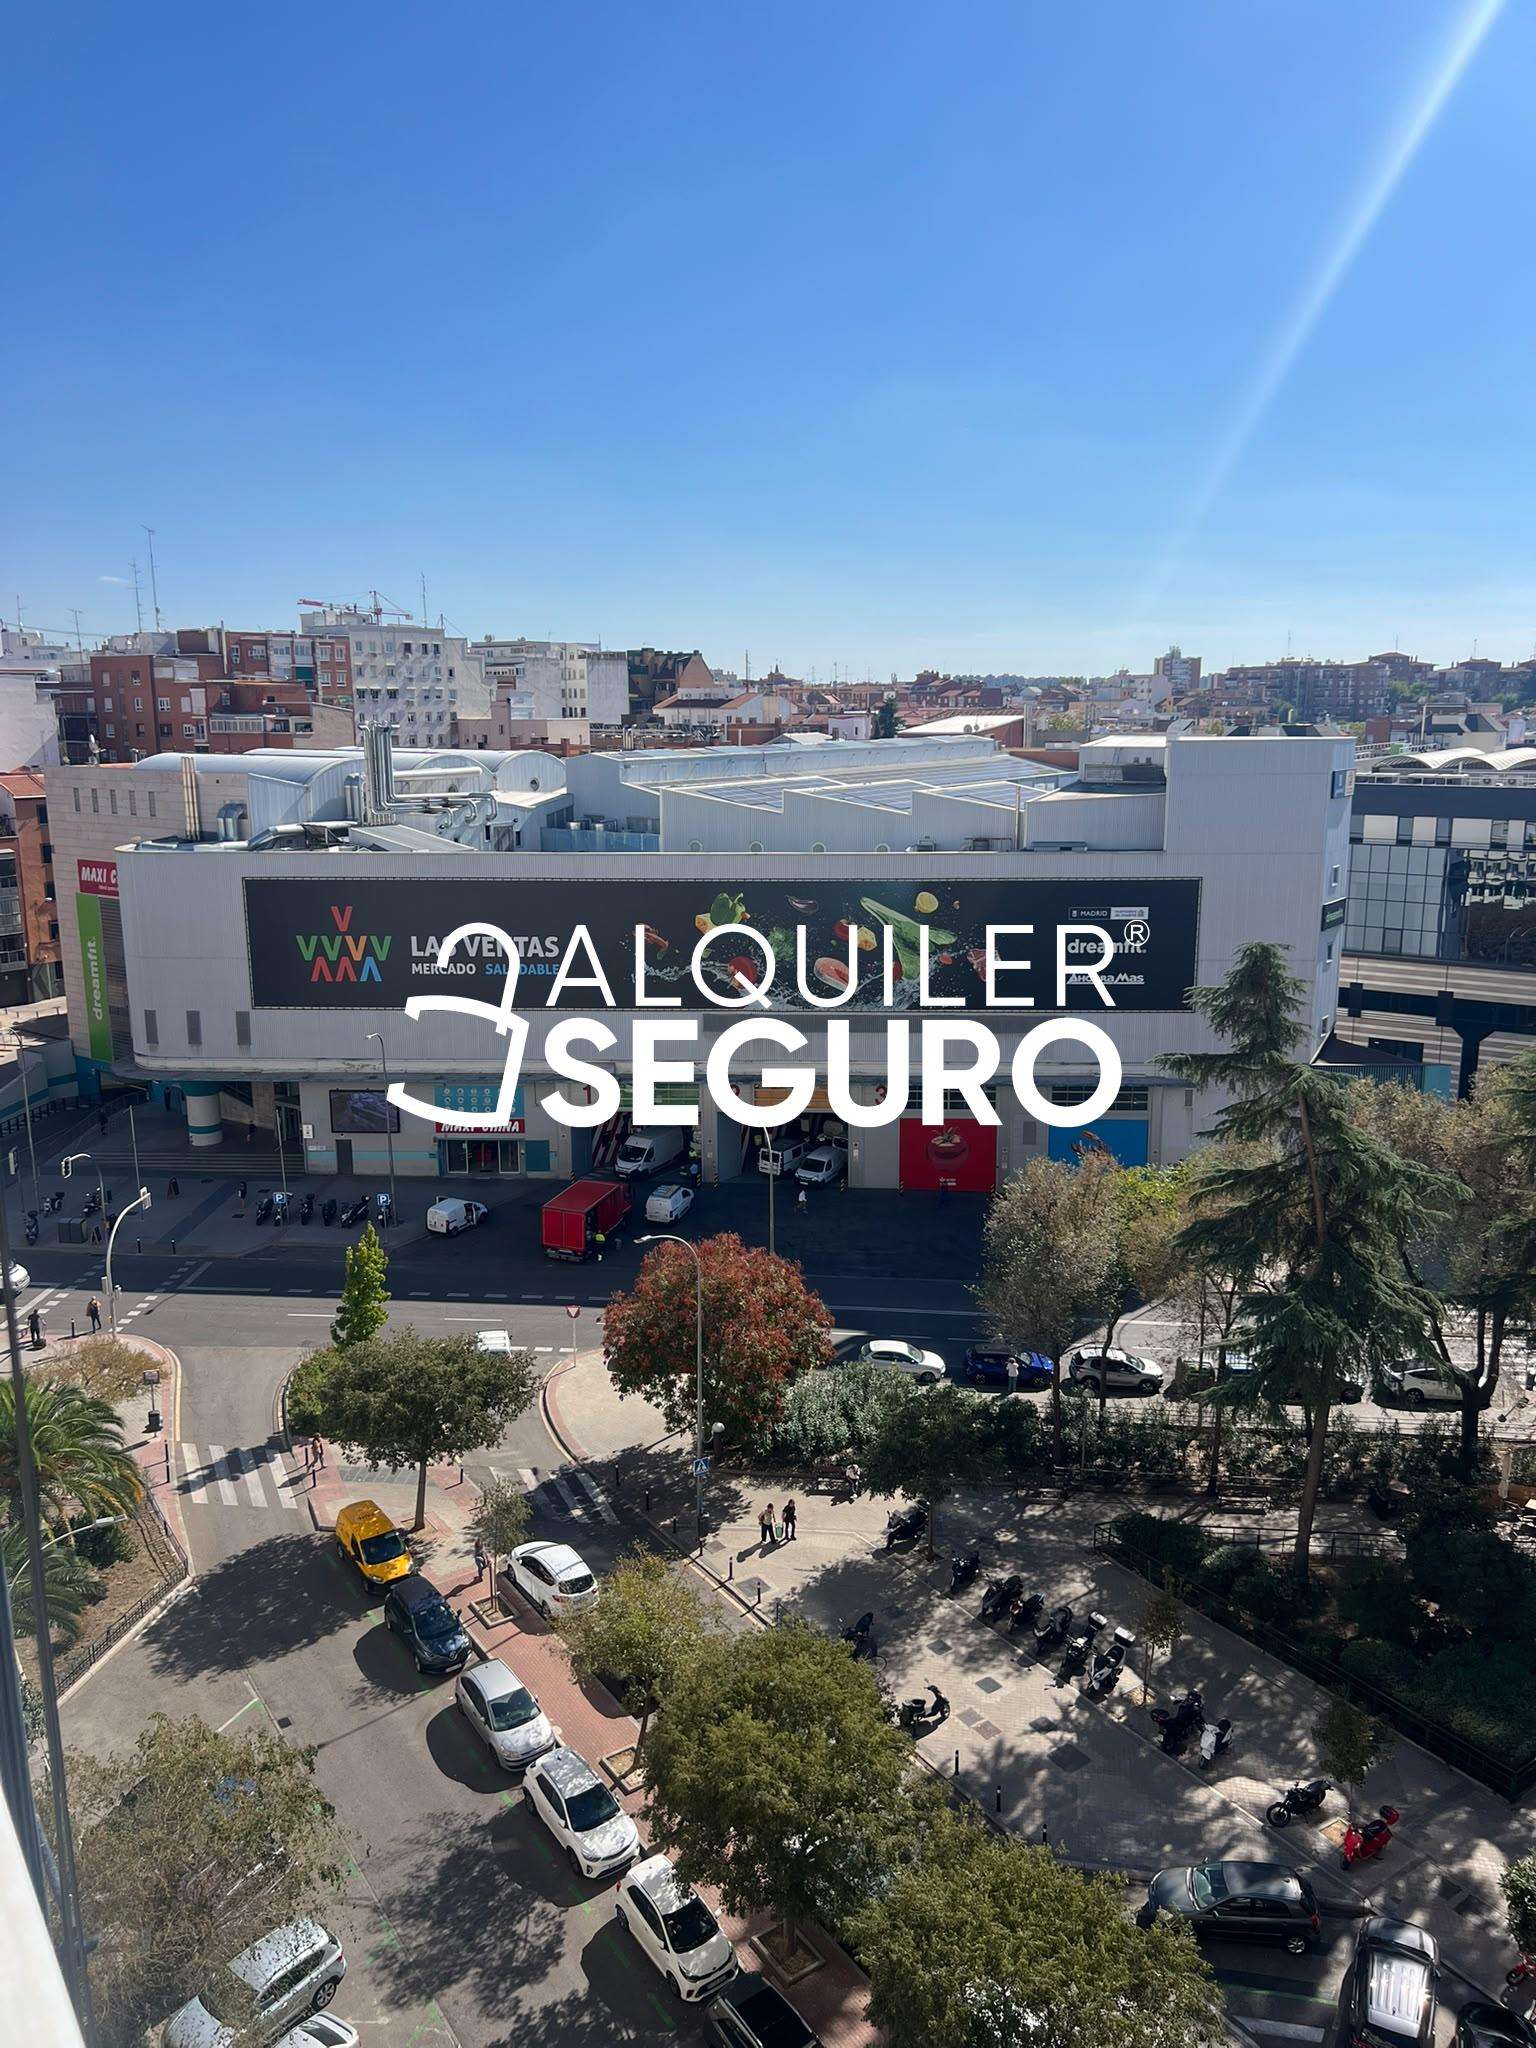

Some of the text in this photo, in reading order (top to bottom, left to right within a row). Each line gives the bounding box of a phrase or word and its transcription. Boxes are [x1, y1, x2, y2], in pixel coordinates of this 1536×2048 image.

[81, 866, 107, 883] MAXI
[411, 963, 560, 976] MERCADO SALDABLE
